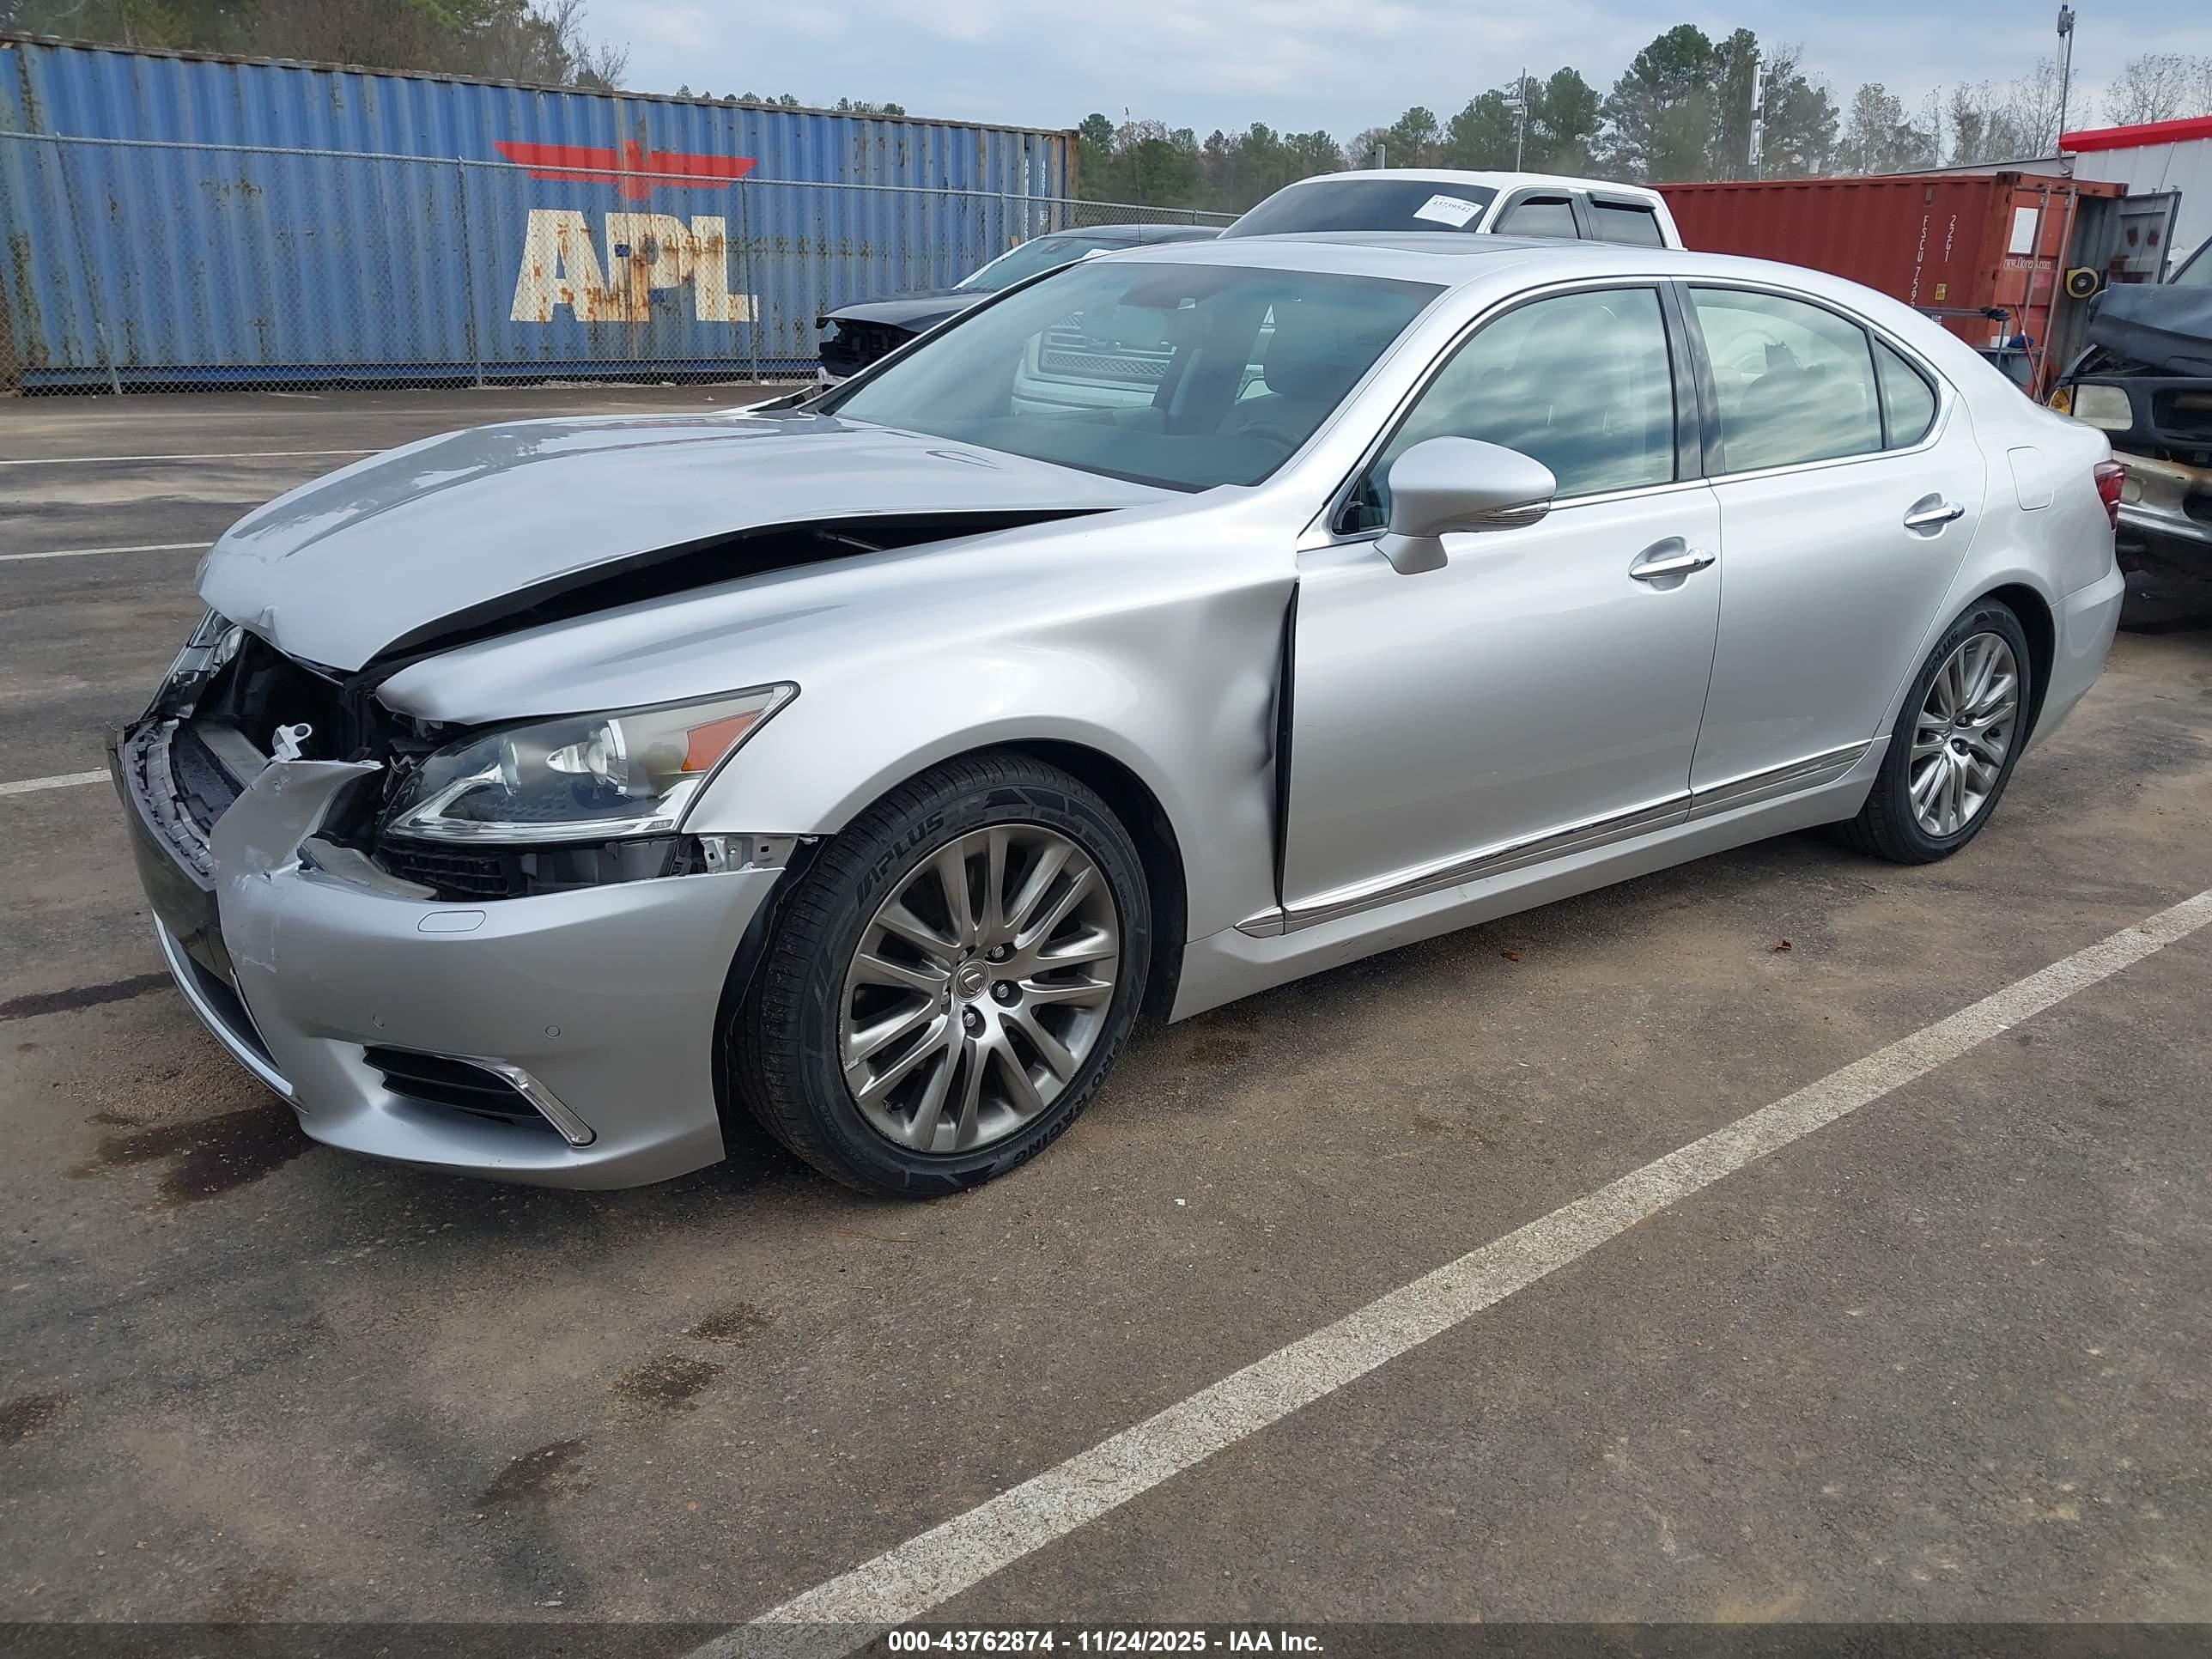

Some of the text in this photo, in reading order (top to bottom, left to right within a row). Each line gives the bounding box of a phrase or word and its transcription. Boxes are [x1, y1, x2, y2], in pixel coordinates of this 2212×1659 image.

[509, 208, 759, 323] APL
[1917, 215, 1929, 263] FSCU
[1944, 214, 1957, 263] 22G1
[1012, 1092, 1088, 1164] RACING
